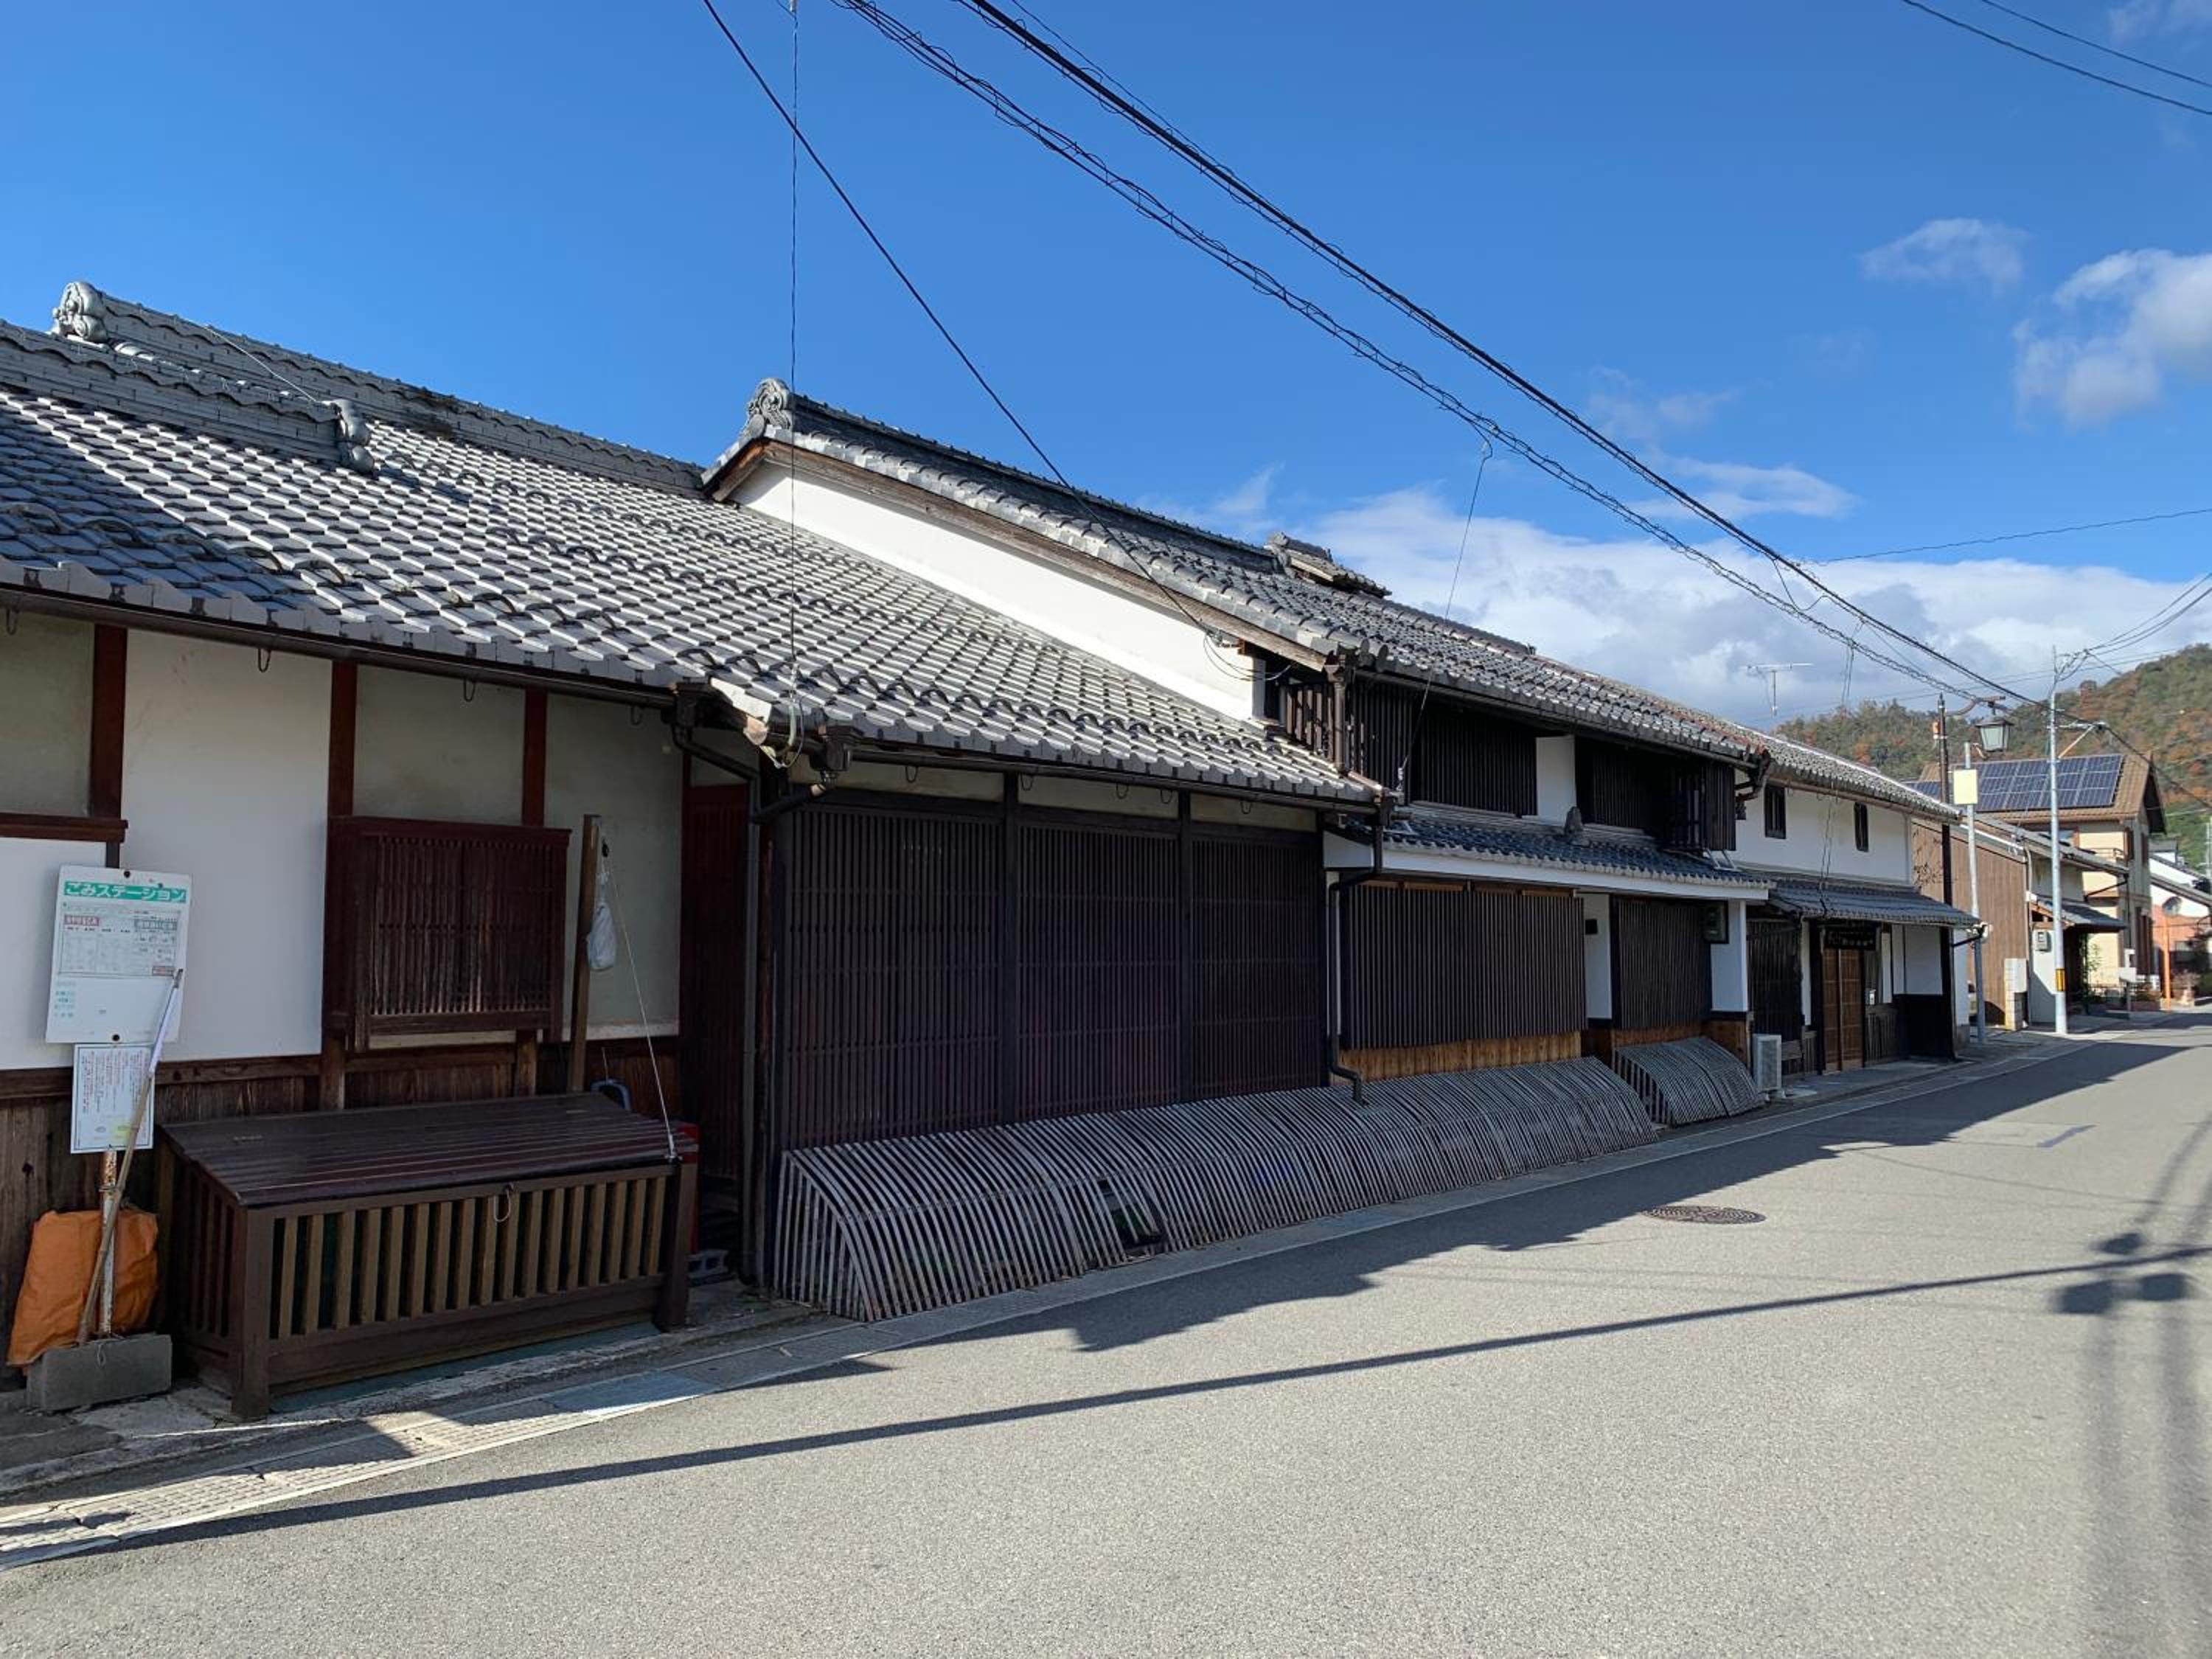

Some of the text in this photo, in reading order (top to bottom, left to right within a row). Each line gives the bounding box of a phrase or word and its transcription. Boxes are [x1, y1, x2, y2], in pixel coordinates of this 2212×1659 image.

[65, 882, 184, 902] ごみステーション
